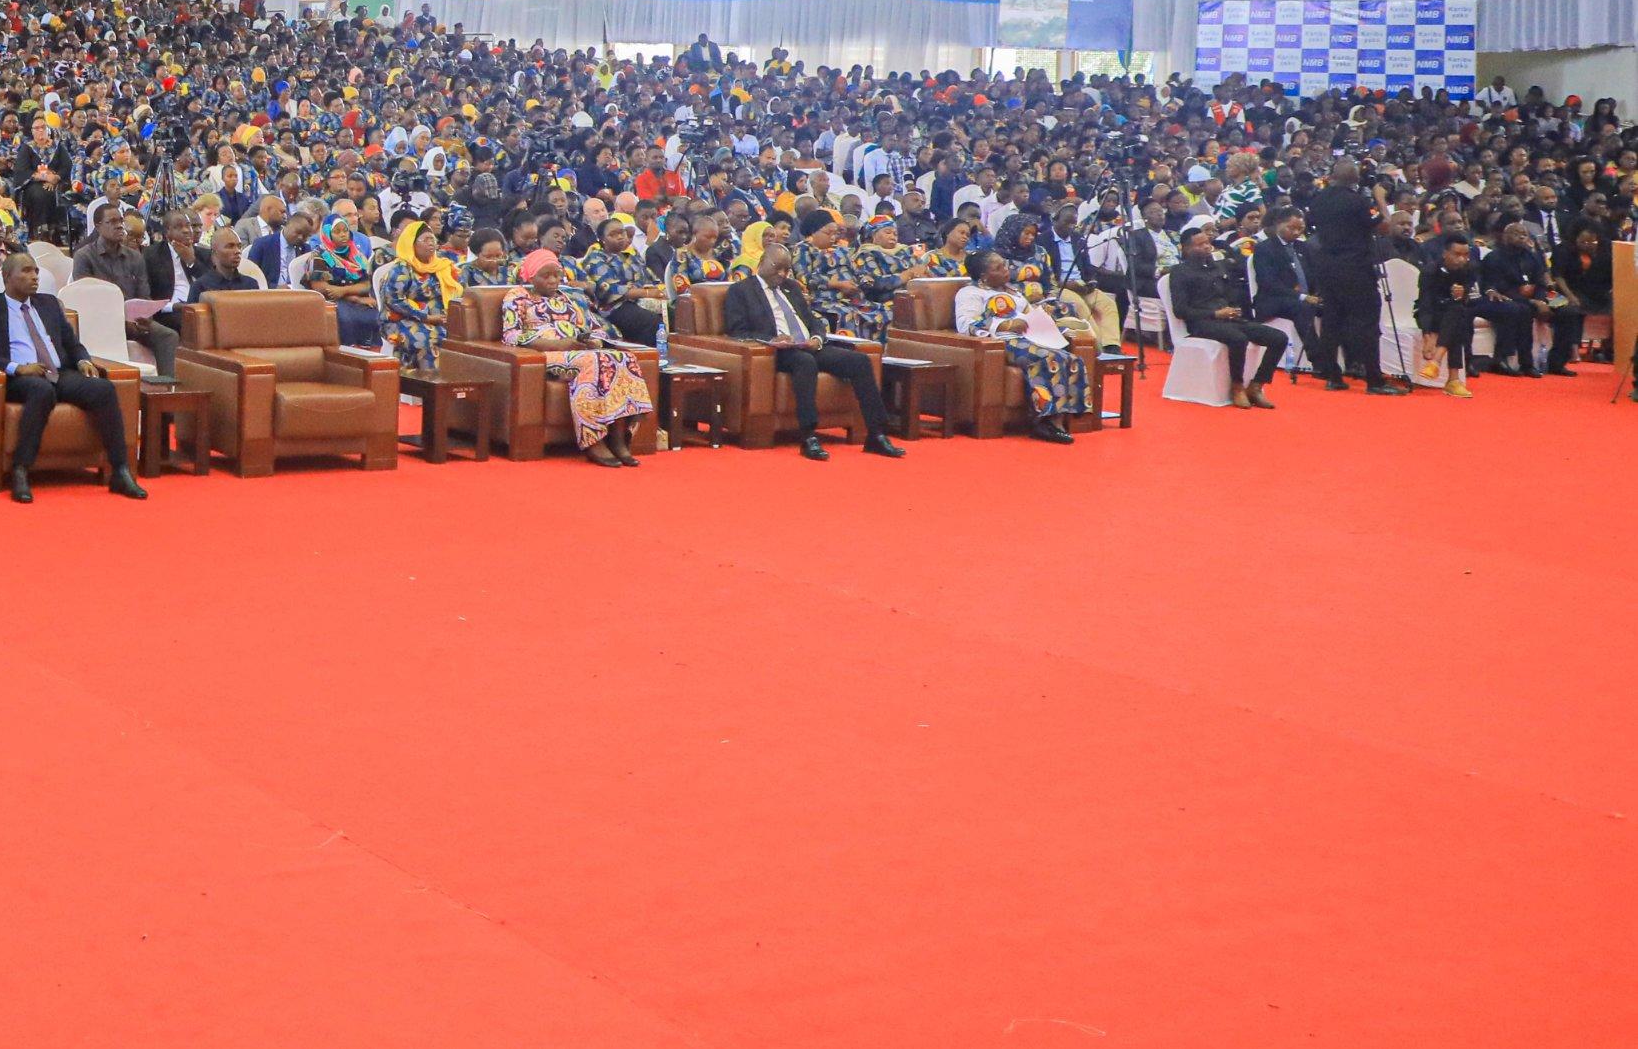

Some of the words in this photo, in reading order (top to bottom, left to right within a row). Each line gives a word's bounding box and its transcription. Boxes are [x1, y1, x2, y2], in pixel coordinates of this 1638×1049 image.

[1199, 10, 1218, 19] NMB
[1250, 10, 1271, 19] NMB
[1304, 10, 1326, 19] NMB
[1359, 10, 1381, 19] NMB
[1416, 10, 1440, 19] NMB
[1224, 34, 1244, 42] NMB
[1276, 34, 1297, 42] NMB
[1330, 34, 1353, 43] NMB
[1387, 35, 1410, 43] NMB
[1446, 35, 1470, 44] NMB
[1196, 57, 1217, 65] NMB
[1248, 58, 1270, 66] NMB
[1302, 58, 1324, 67] NMB
[1358, 59, 1380, 68] NMB
[1416, 60, 1439, 69] NMB
[1446, 85, 1470, 94] NMB
